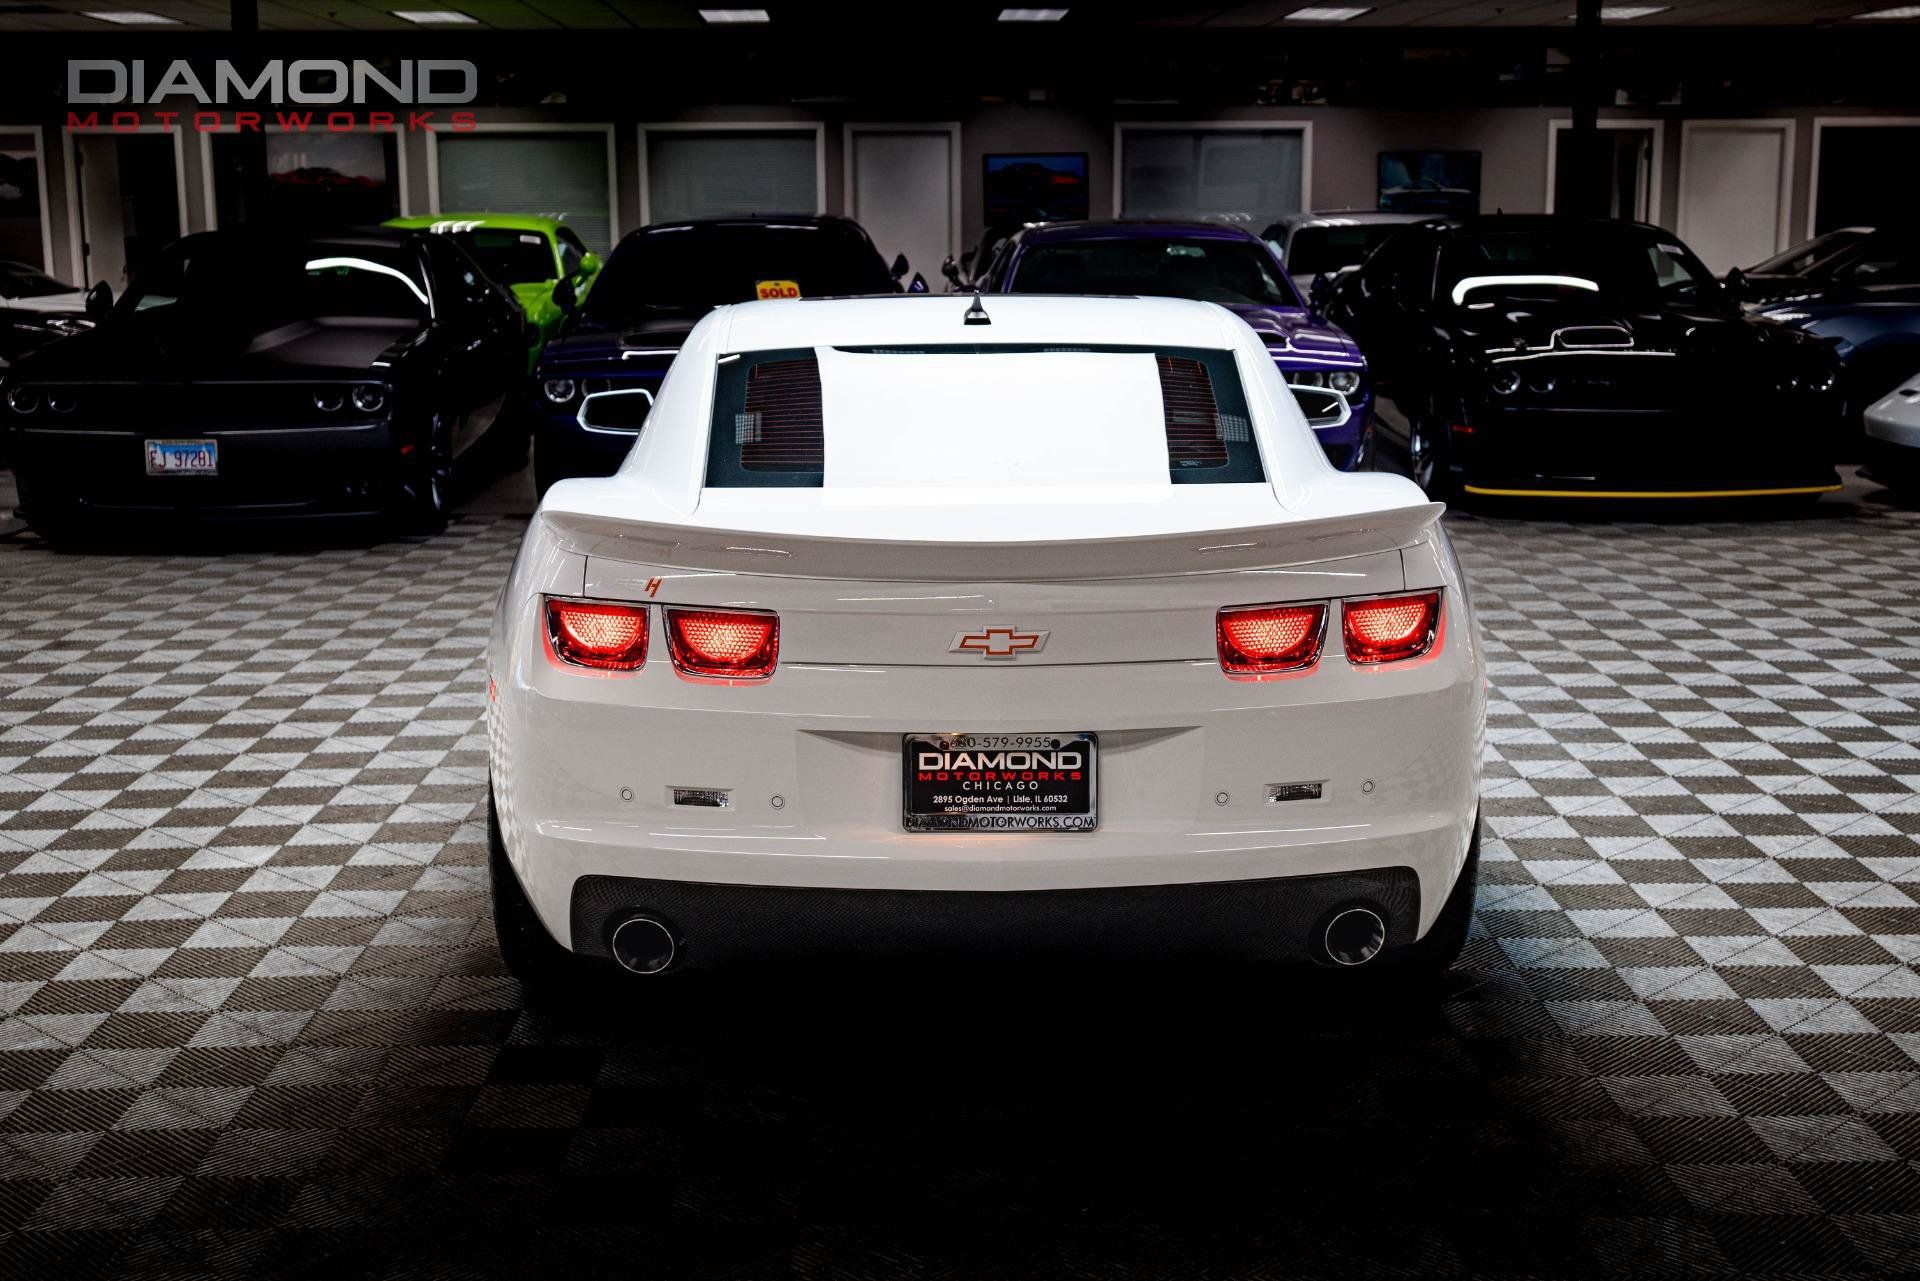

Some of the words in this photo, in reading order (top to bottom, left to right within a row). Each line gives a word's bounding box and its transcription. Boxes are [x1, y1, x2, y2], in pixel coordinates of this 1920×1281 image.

[760, 287, 797, 298] SOLD
[174, 451, 213, 467] 97281
[918, 752, 1082, 770] DIAMOND
[918, 772, 1082, 781] MOTORWORKS
[962, 781, 1039, 790] CHICAGO
[933, 795, 953, 804] 2895
[955, 795, 984, 805] Ogden
[986, 795, 1004, 804] Ave
[1013, 795, 1033, 804] Lisle,
[1035, 795, 1041, 804] IL
[1043, 795, 1068, 803] 60532
[944, 804, 1057, 812] sales@diamondmotorworks.com
[906, 816, 1095, 828] DIANDMOTORWORKS.COM
